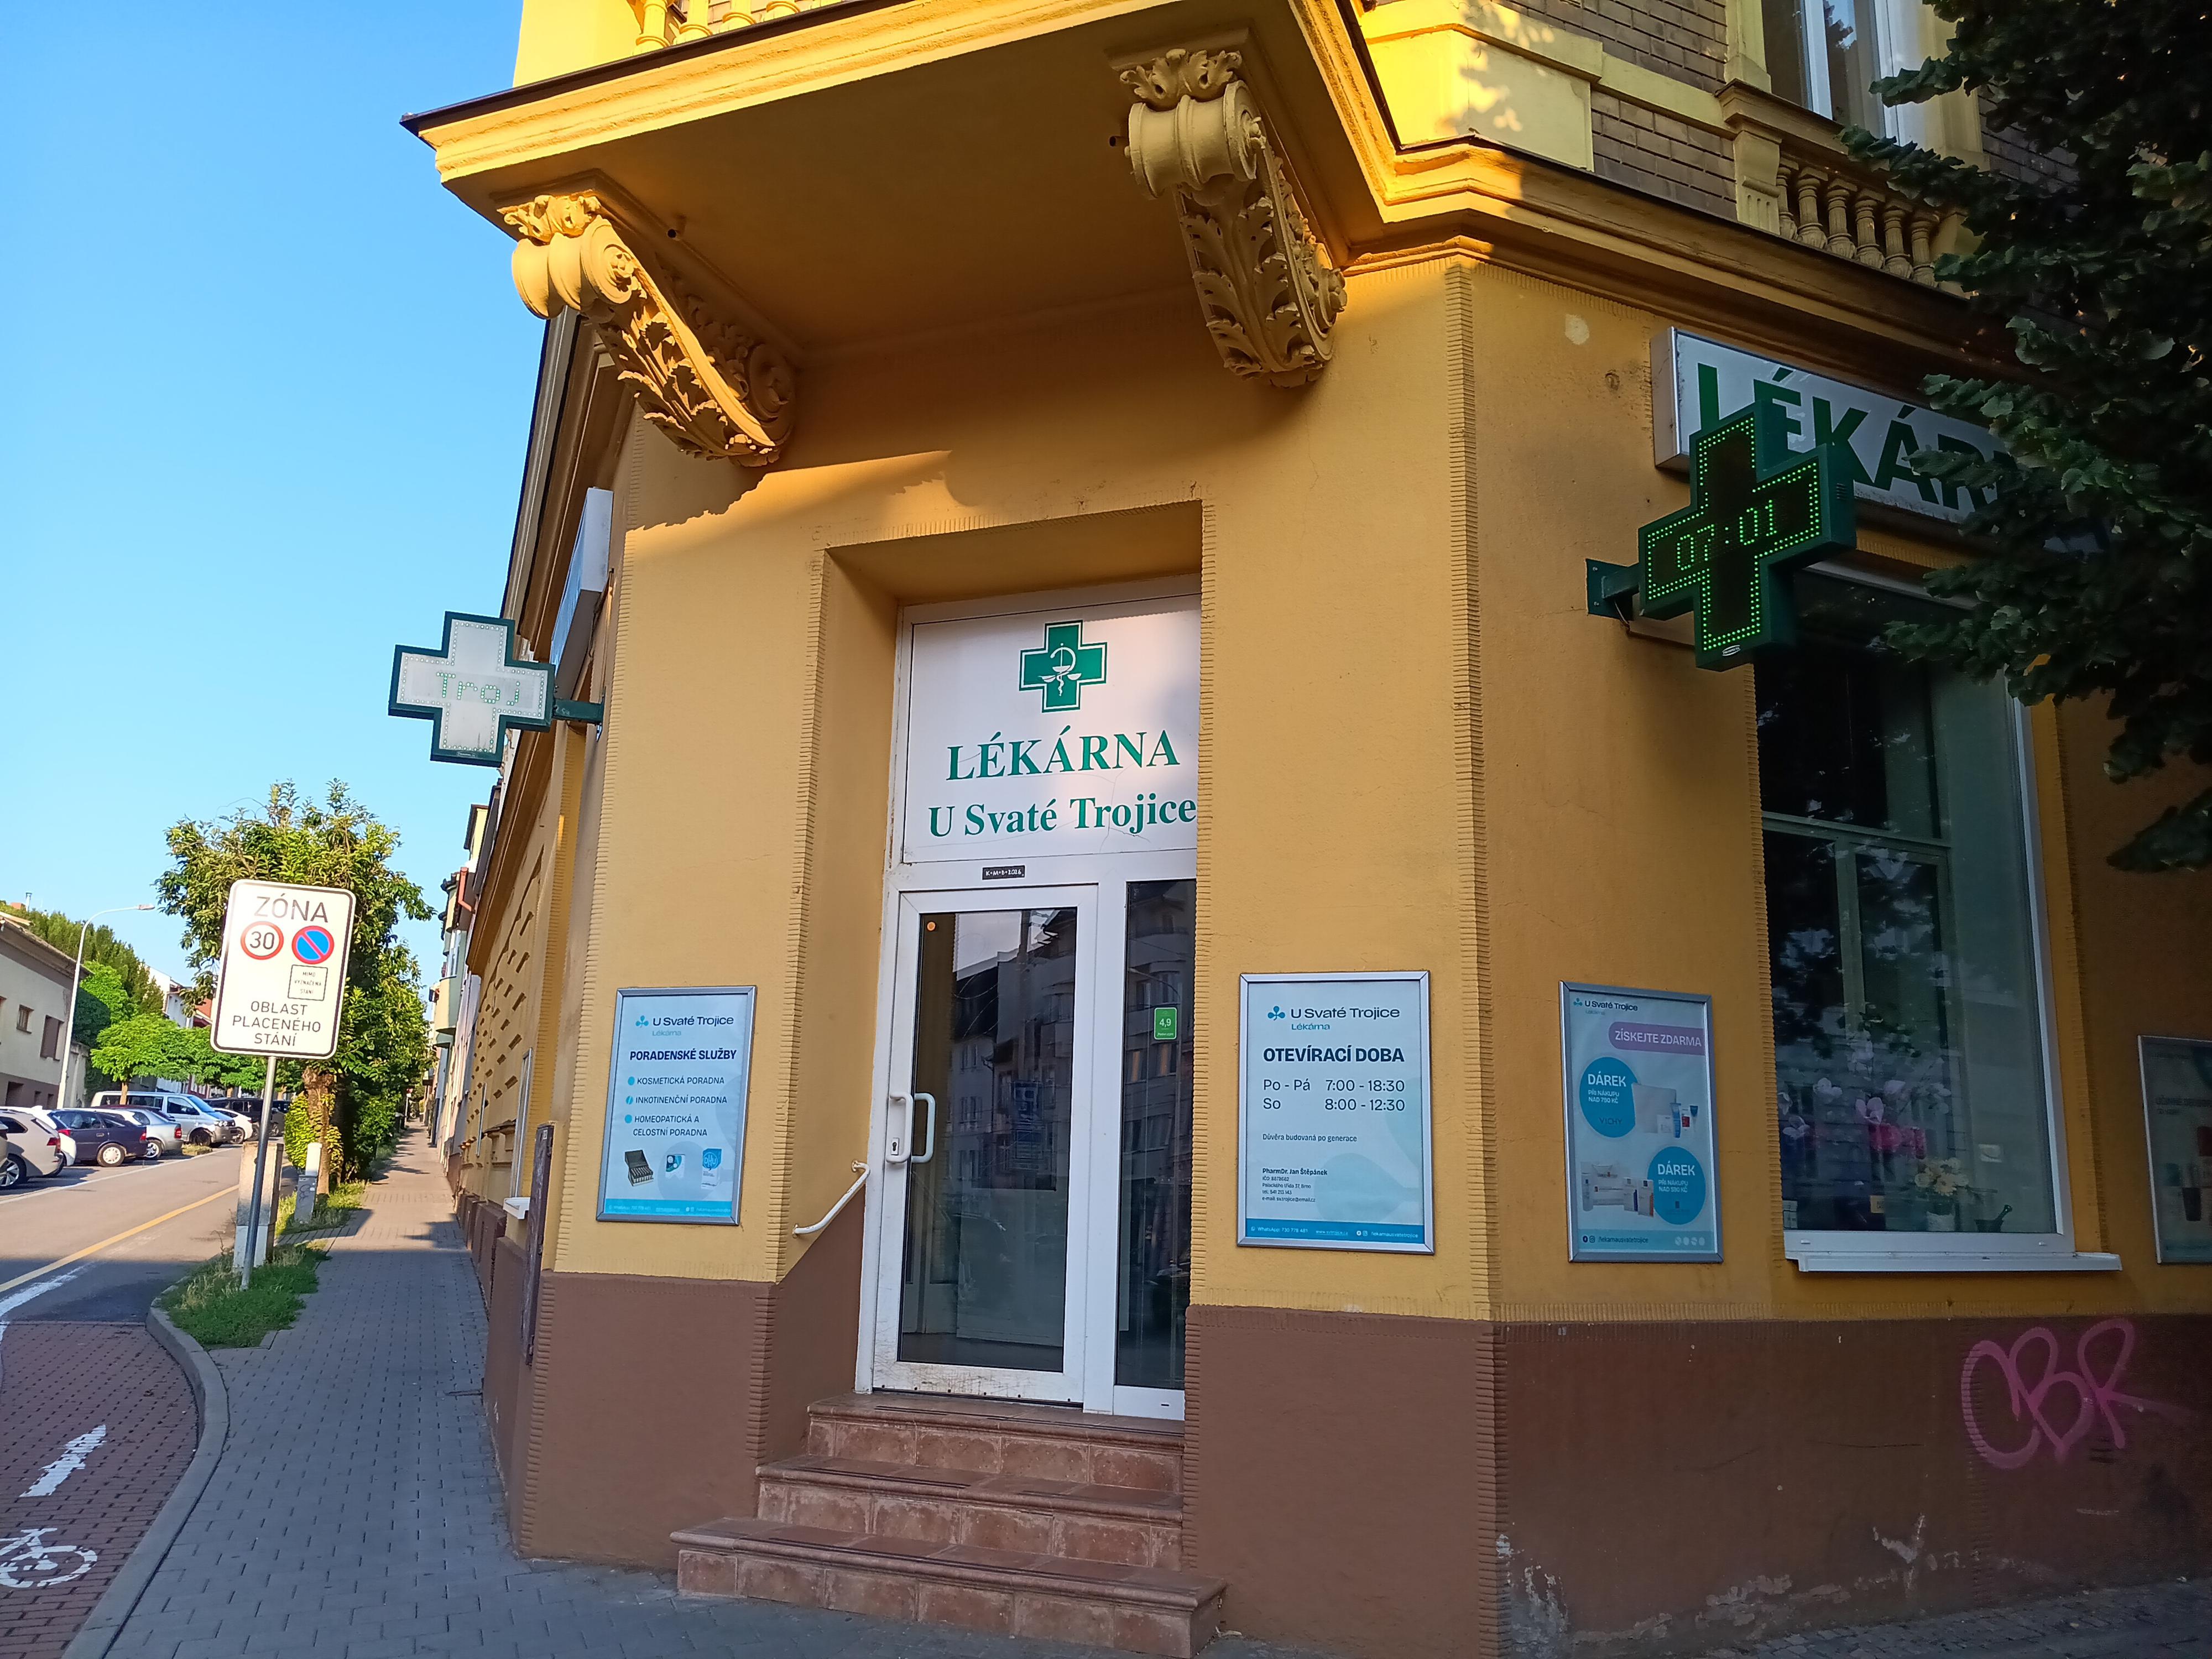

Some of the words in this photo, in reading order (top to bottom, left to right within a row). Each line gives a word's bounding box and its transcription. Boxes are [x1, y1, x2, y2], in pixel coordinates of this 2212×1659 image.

[1698, 364, 2018, 512] LÉKÁR
[1676, 498, 1775, 571] 07:01
[946, 725, 1181, 781] LÉKÁRNA
[928, 806, 956, 837] U
[964, 799, 1057, 836] Svaté
[1070, 793, 1196, 834] Trojice
[254, 893, 328, 923] ZÓNA
[249, 931, 275, 950] 30
[251, 1000, 308, 1015] OBLAST
[1592, 1000, 1613, 1009] Svaté
[1614, 1003, 1638, 1011] Trojice
[664, 1016, 695, 1026] Svaté
[697, 1016, 734, 1026] Trojice
[1291, 1009, 1301, 1019] U
[1304, 1007, 1347, 1018] Svaté
[1349, 1007, 1400, 1020] Trojice
[232, 1015, 321, 1032] PLACENÉHO
[1159, 1018, 1171, 1027] 4,9
[254, 1031, 296, 1046] STÁNÍ
[1615, 1028, 1659, 1044] ZÍSKEJTE
[1660, 1034, 1702, 1047] ZDARMA
[630, 1048, 696, 1060] PORADENSKÉ
[698, 1047, 737, 1060] SLUŽBY
[1263, 1045, 1352, 1062] OTEVÍRACÍ
[1355, 1048, 1405, 1062] DOBA
[637, 1076, 685, 1084] KOSMETICKÁ
[1263, 1079, 1281, 1091] Po
[1293, 1078, 1311, 1091] Pá
[1326, 1079, 1355, 1092] 7:00
[1368, 1080, 1405, 1092] 18:30
[1588, 1071, 1626, 1087] DÁREK
[636, 1094, 688, 1104] INKOTINENČNÍ
[1263, 1098, 1281, 1109] So
[1324, 1099, 1357, 1110] 8:00
[1369, 1099, 1405, 1111] 12:30
[635, 1114, 692, 1123] HOMEOPATICKÁ
[633, 1127, 668, 1136] CELOSTNÍ
[704, 1154, 716, 1167] DHU
[1657, 1161, 1695, 1176] DÁREK
